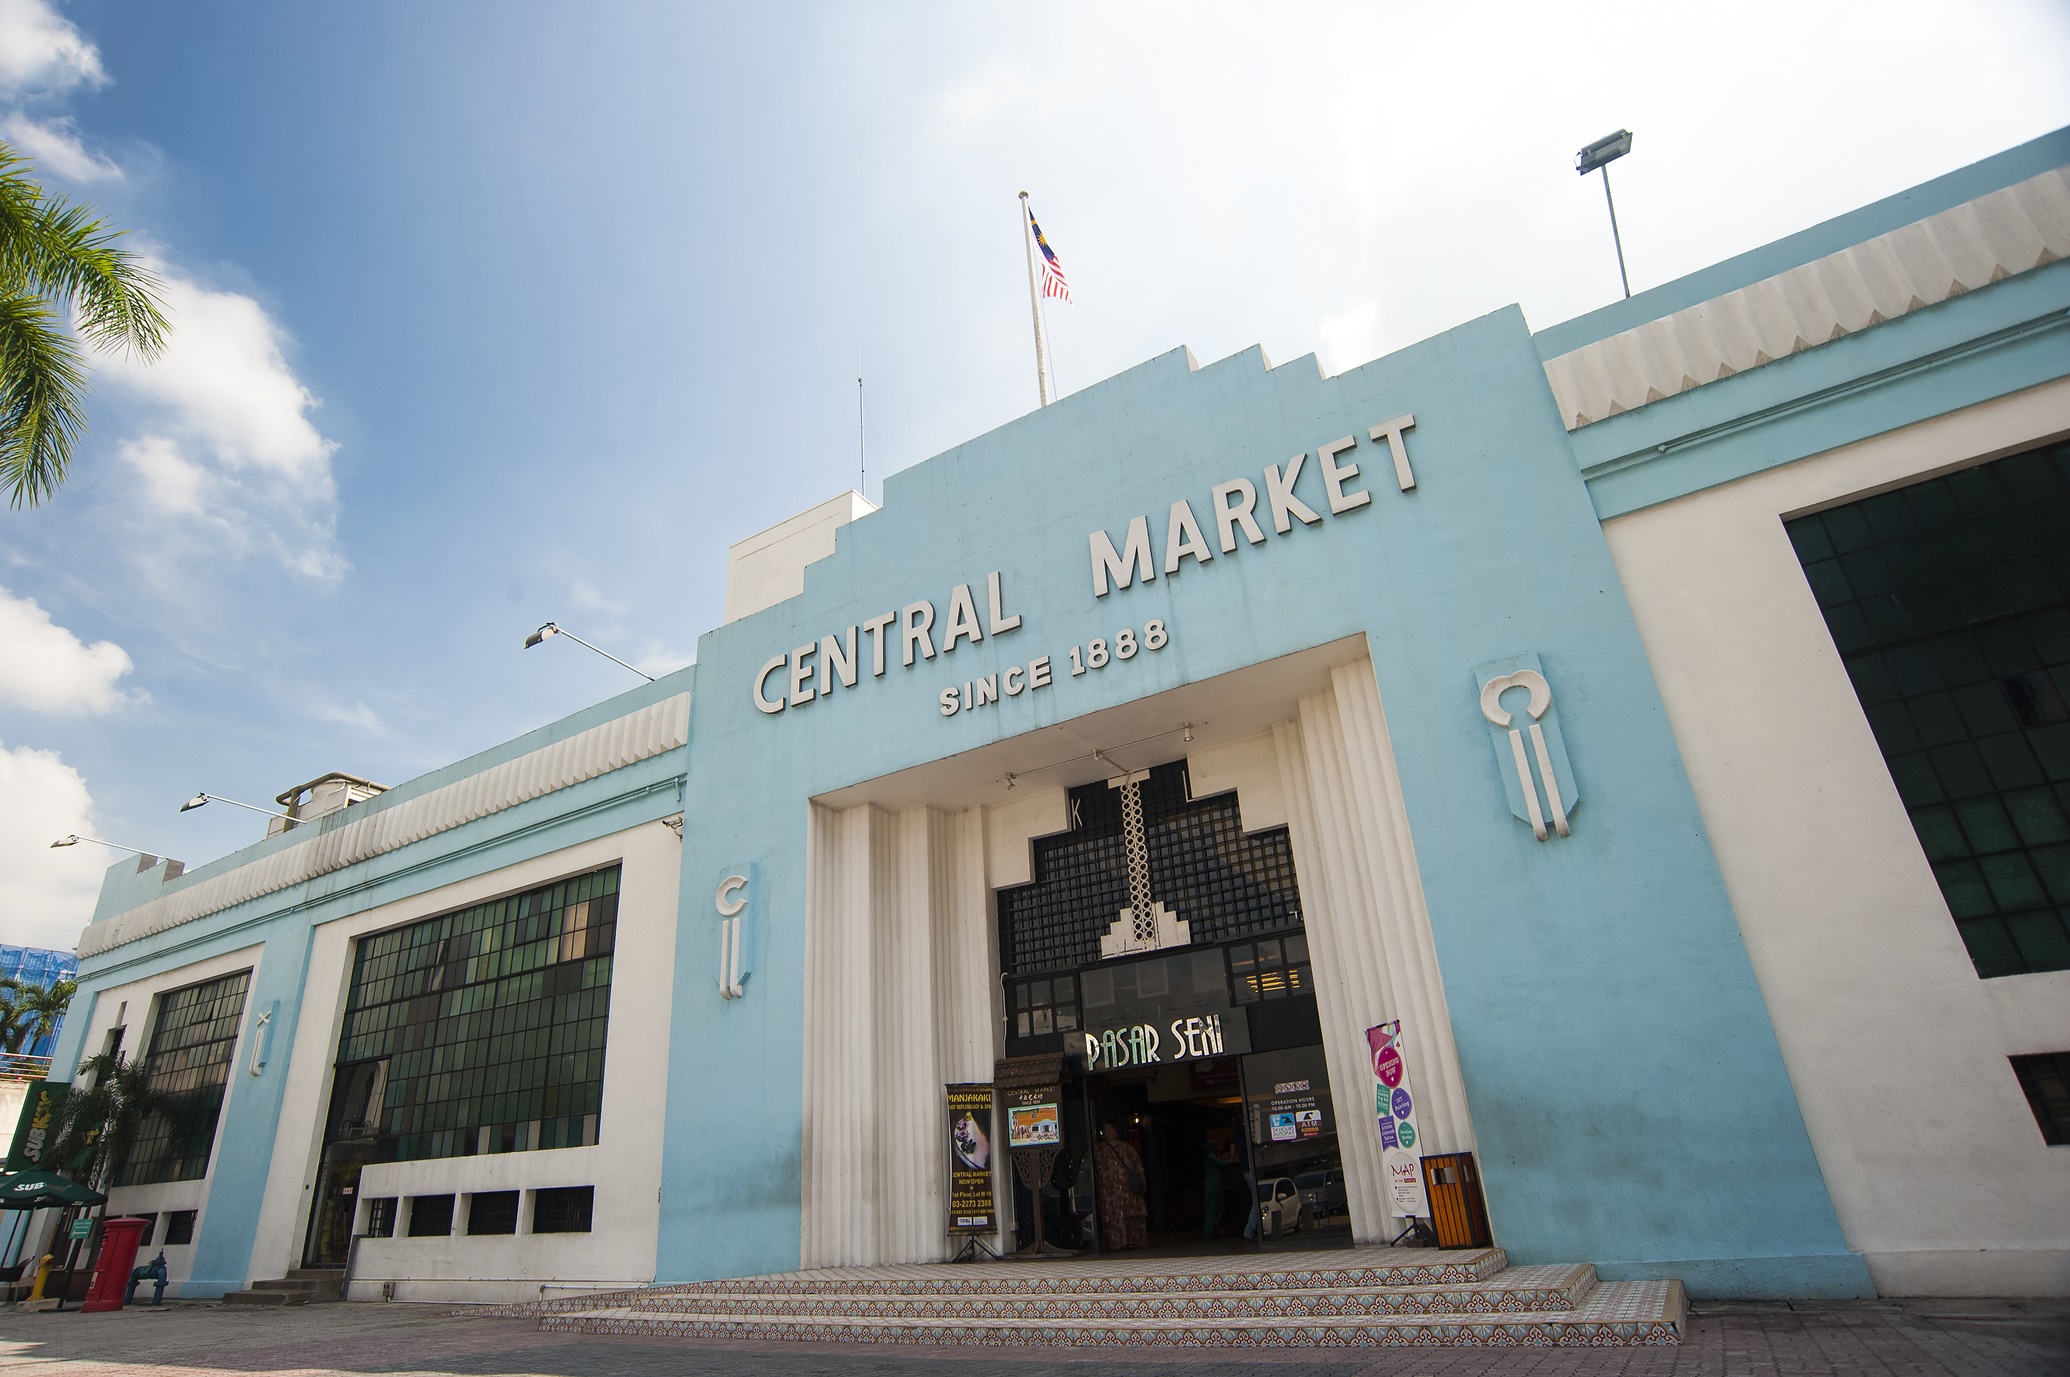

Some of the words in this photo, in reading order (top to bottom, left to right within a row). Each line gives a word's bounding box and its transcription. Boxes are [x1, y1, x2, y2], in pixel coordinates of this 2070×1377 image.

[753, 570, 1022, 714] CENTRAL
[1089, 413, 1417, 598] MARKET
[939, 655, 1052, 717] SINCE
[1069, 618, 1169, 677] 1888
[1085, 1023, 1161, 1071] PASAR
[1170, 1014, 1224, 1060] SENI
[1379, 1057, 1399, 1071] OPENING
[1386, 1066, 1396, 1077] NOW
[1391, 1163, 1415, 1177] MAP
